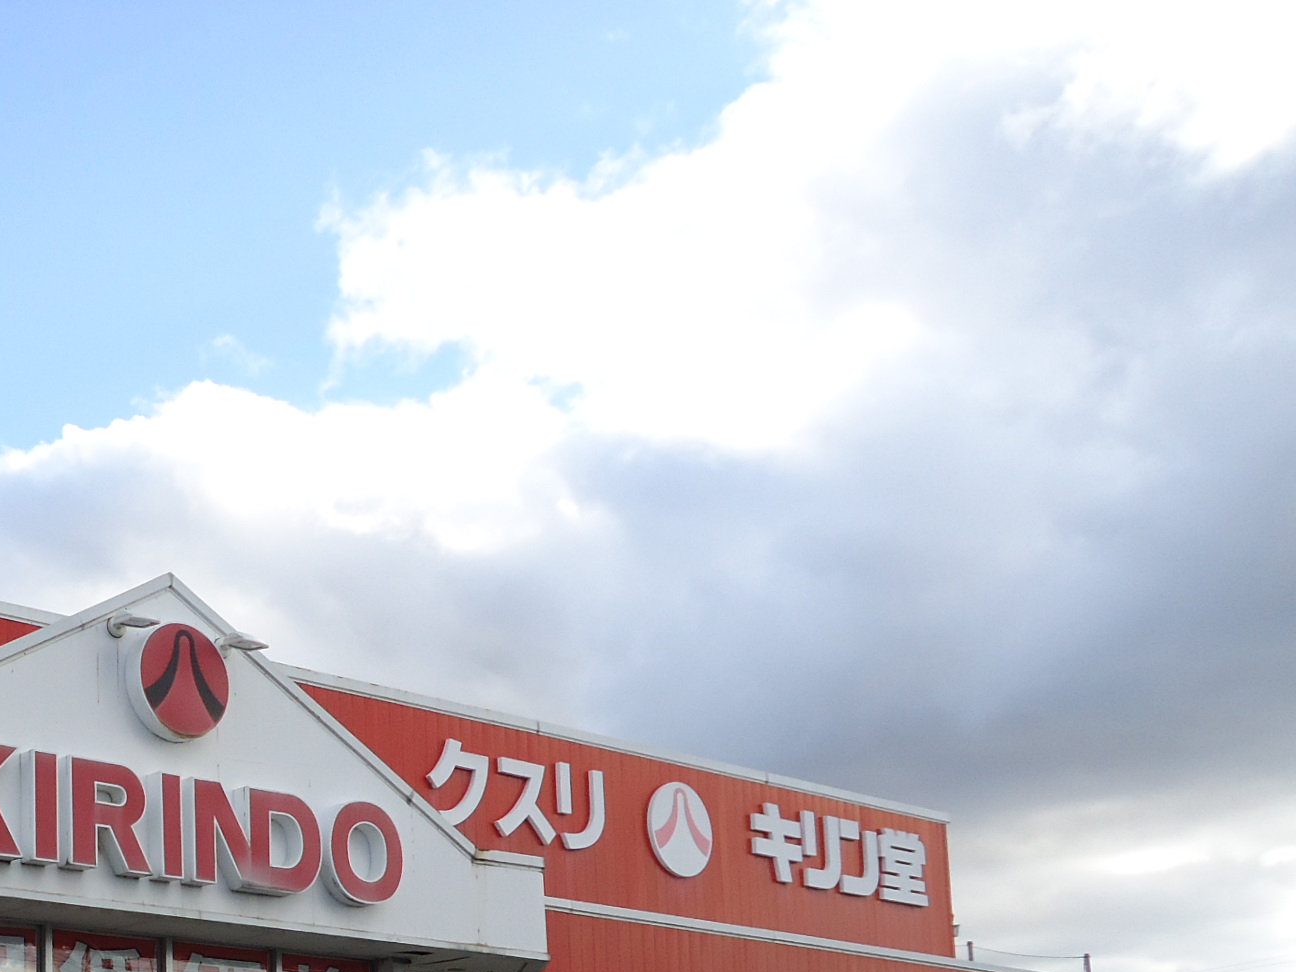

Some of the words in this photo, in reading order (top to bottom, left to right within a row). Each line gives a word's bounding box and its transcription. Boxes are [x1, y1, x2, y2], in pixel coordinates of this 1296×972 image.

[426, 738, 605, 850] クスリ
[750, 802, 929, 907] キリン堂
